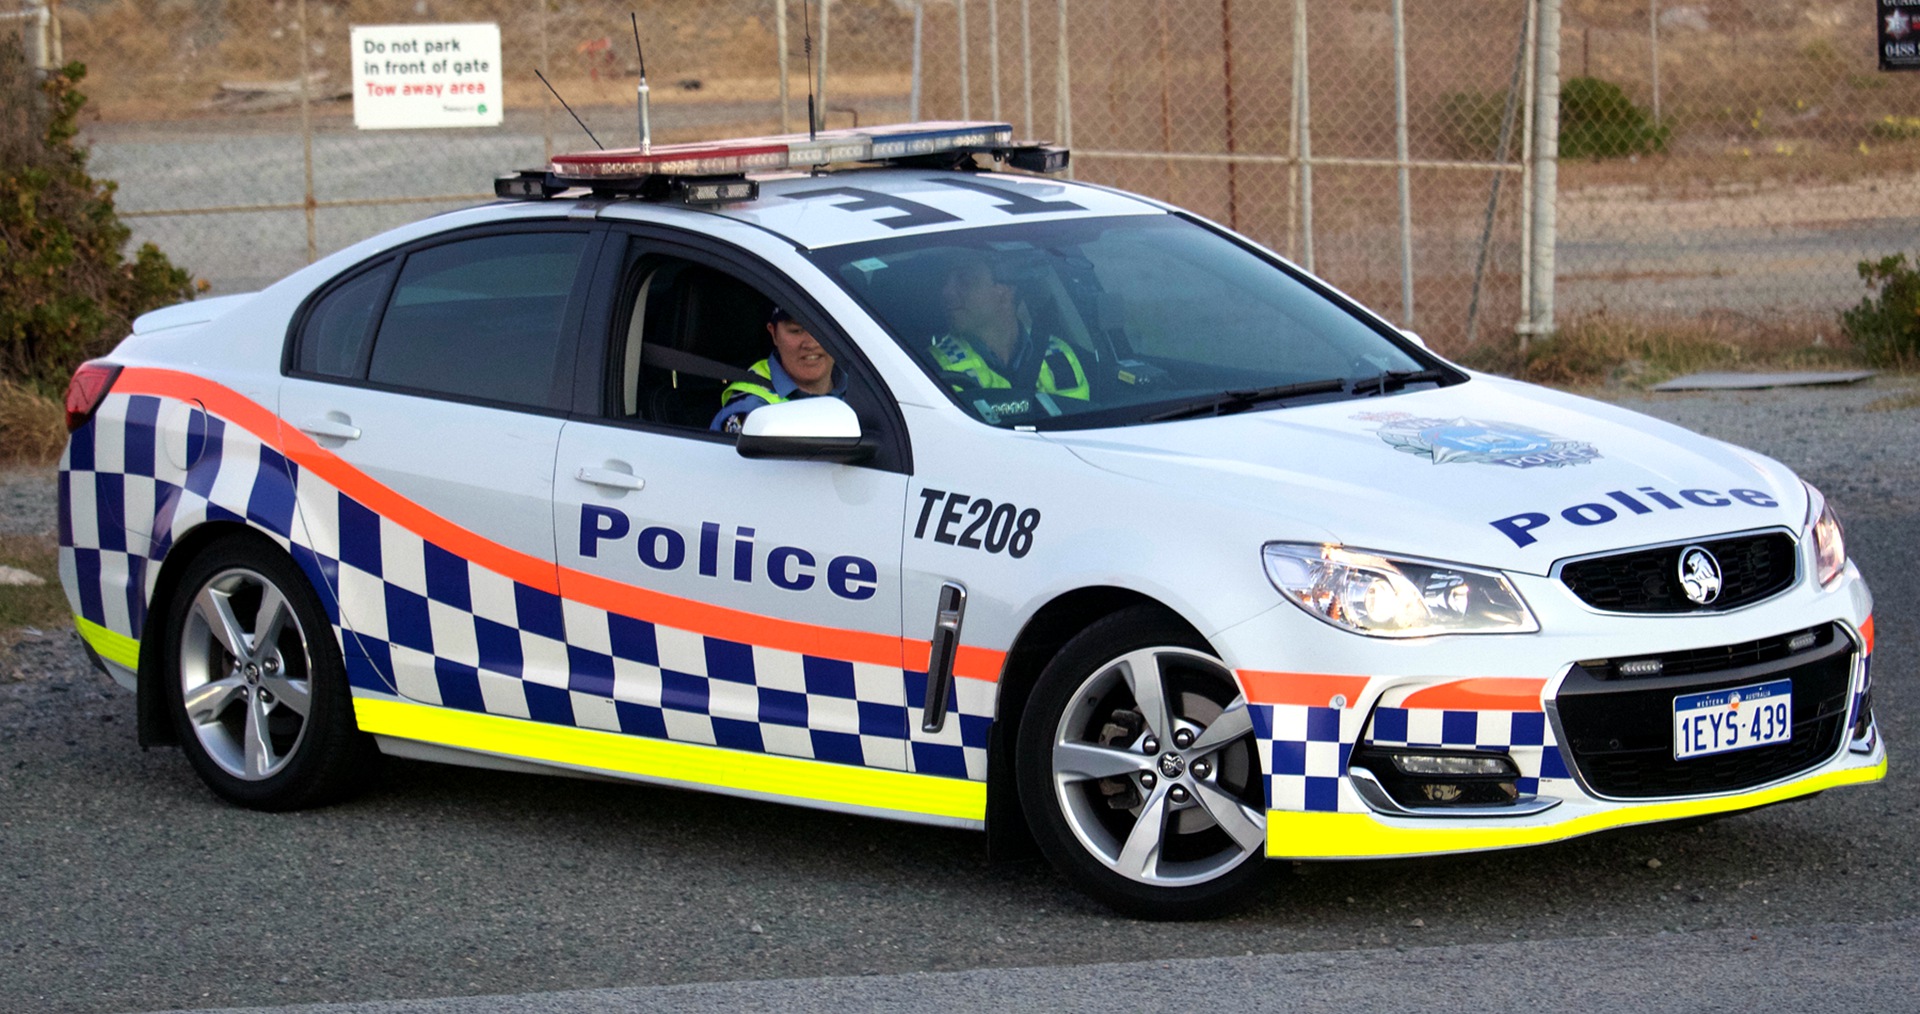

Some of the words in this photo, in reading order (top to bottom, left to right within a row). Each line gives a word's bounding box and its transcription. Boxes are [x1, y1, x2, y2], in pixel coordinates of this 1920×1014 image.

[363, 40, 385, 54] Do
[391, 40, 418, 53] not
[424, 38, 461, 54] park
[364, 62, 379, 75] in
[385, 60, 426, 74] front
[432, 59, 447, 73] of
[453, 59, 489, 75] gate
[366, 83, 396, 97] Tow
[402, 83, 443, 97] away
[450, 83, 485, 95] area
[914, 488, 1041, 559] TE208
[1489, 486, 1779, 549] Police
[578, 503, 878, 601] Police
[1697, 698, 1725, 708] WESTERN
[1746, 690, 1771, 700] AUSTRALIA
